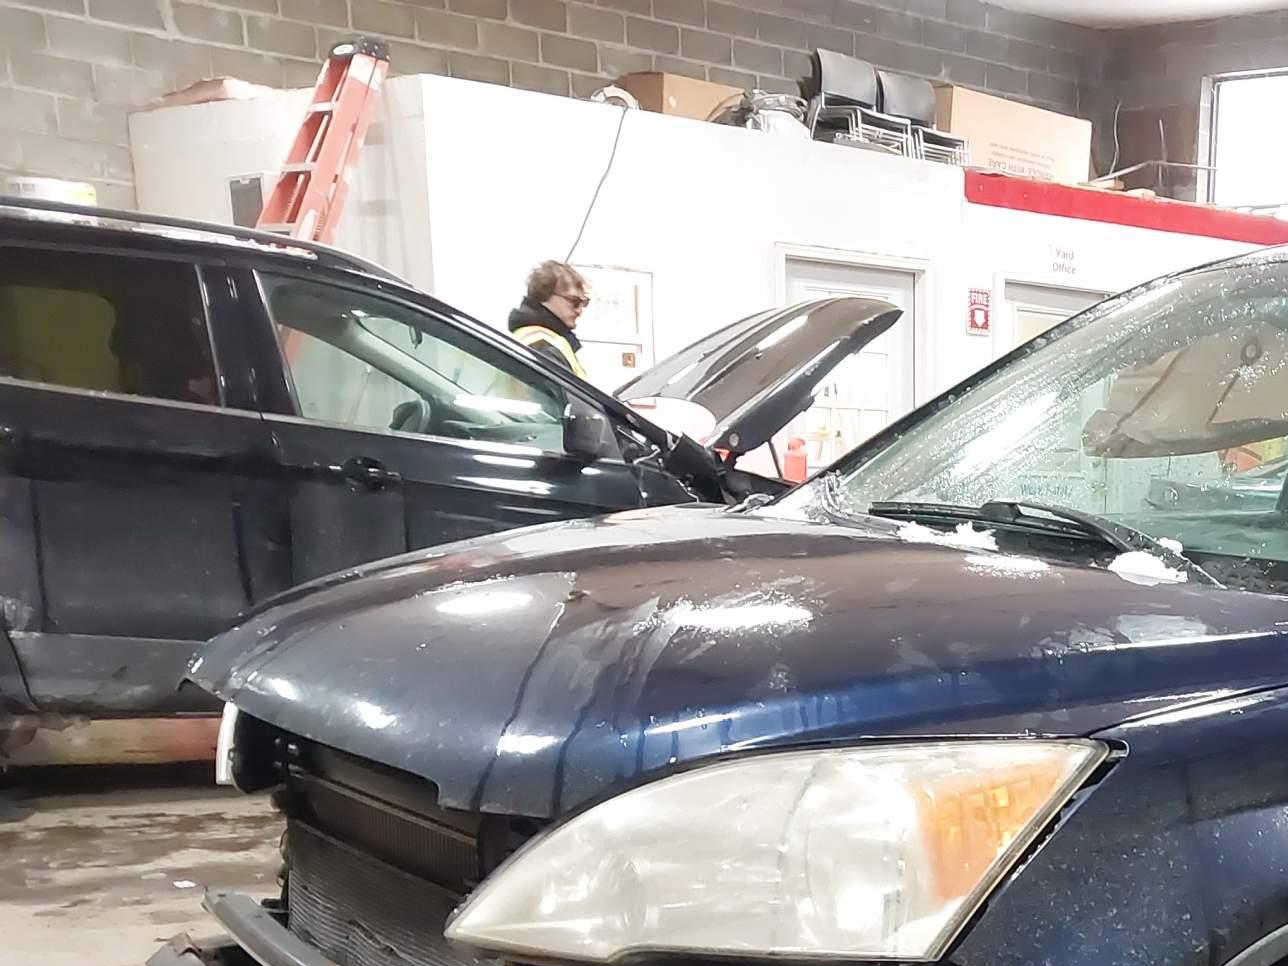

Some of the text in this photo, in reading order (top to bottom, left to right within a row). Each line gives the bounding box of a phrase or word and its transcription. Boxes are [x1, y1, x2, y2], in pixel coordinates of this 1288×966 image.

[1055, 248, 1074, 260] Yard
[1052, 262, 1077, 275] Office
[971, 292, 989, 305] FIRE
